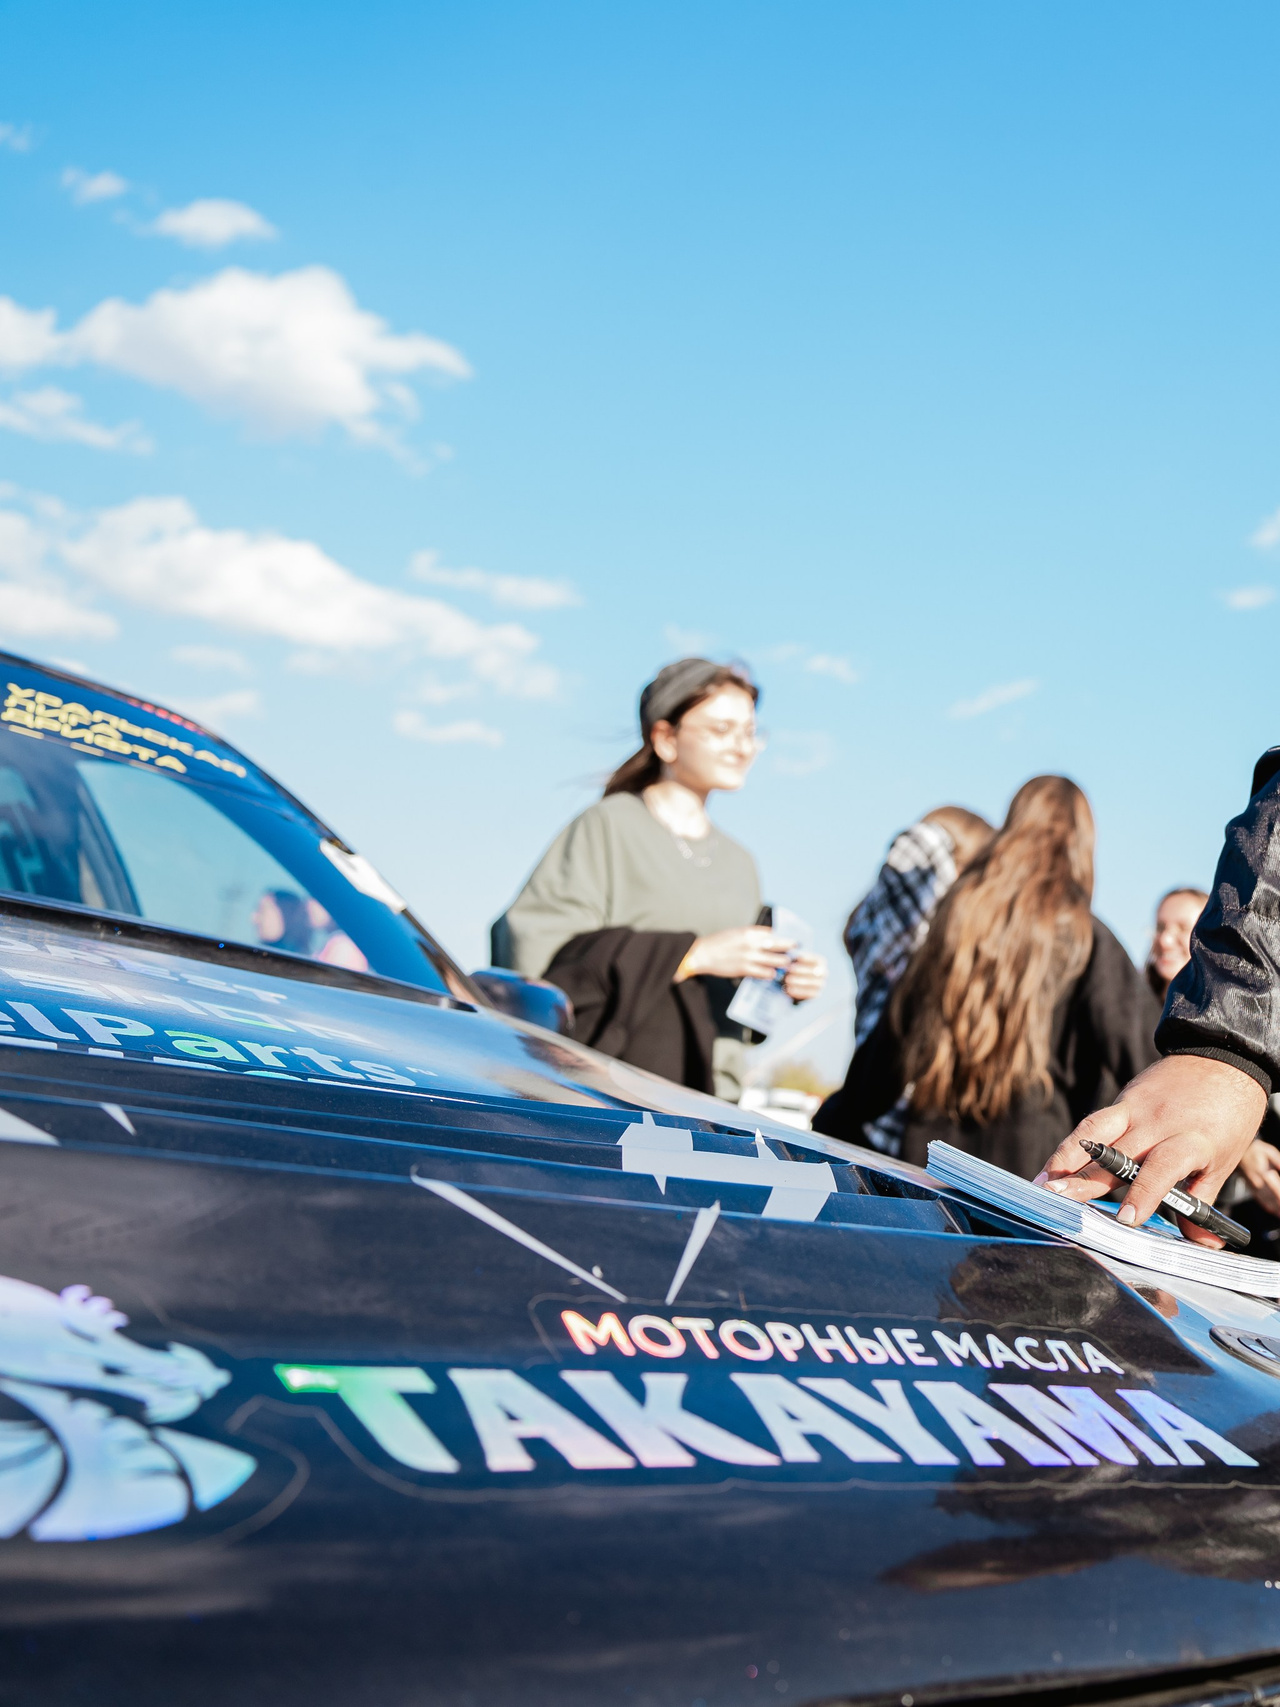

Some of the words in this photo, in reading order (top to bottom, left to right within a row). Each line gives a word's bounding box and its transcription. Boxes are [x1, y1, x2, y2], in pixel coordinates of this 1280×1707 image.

[561, 1310, 939, 1367] МОТОРНЫЕ
[931, 1330, 1125, 1375] МАСЛА
[274, 1363, 1260, 1474] TAKAYAMA
